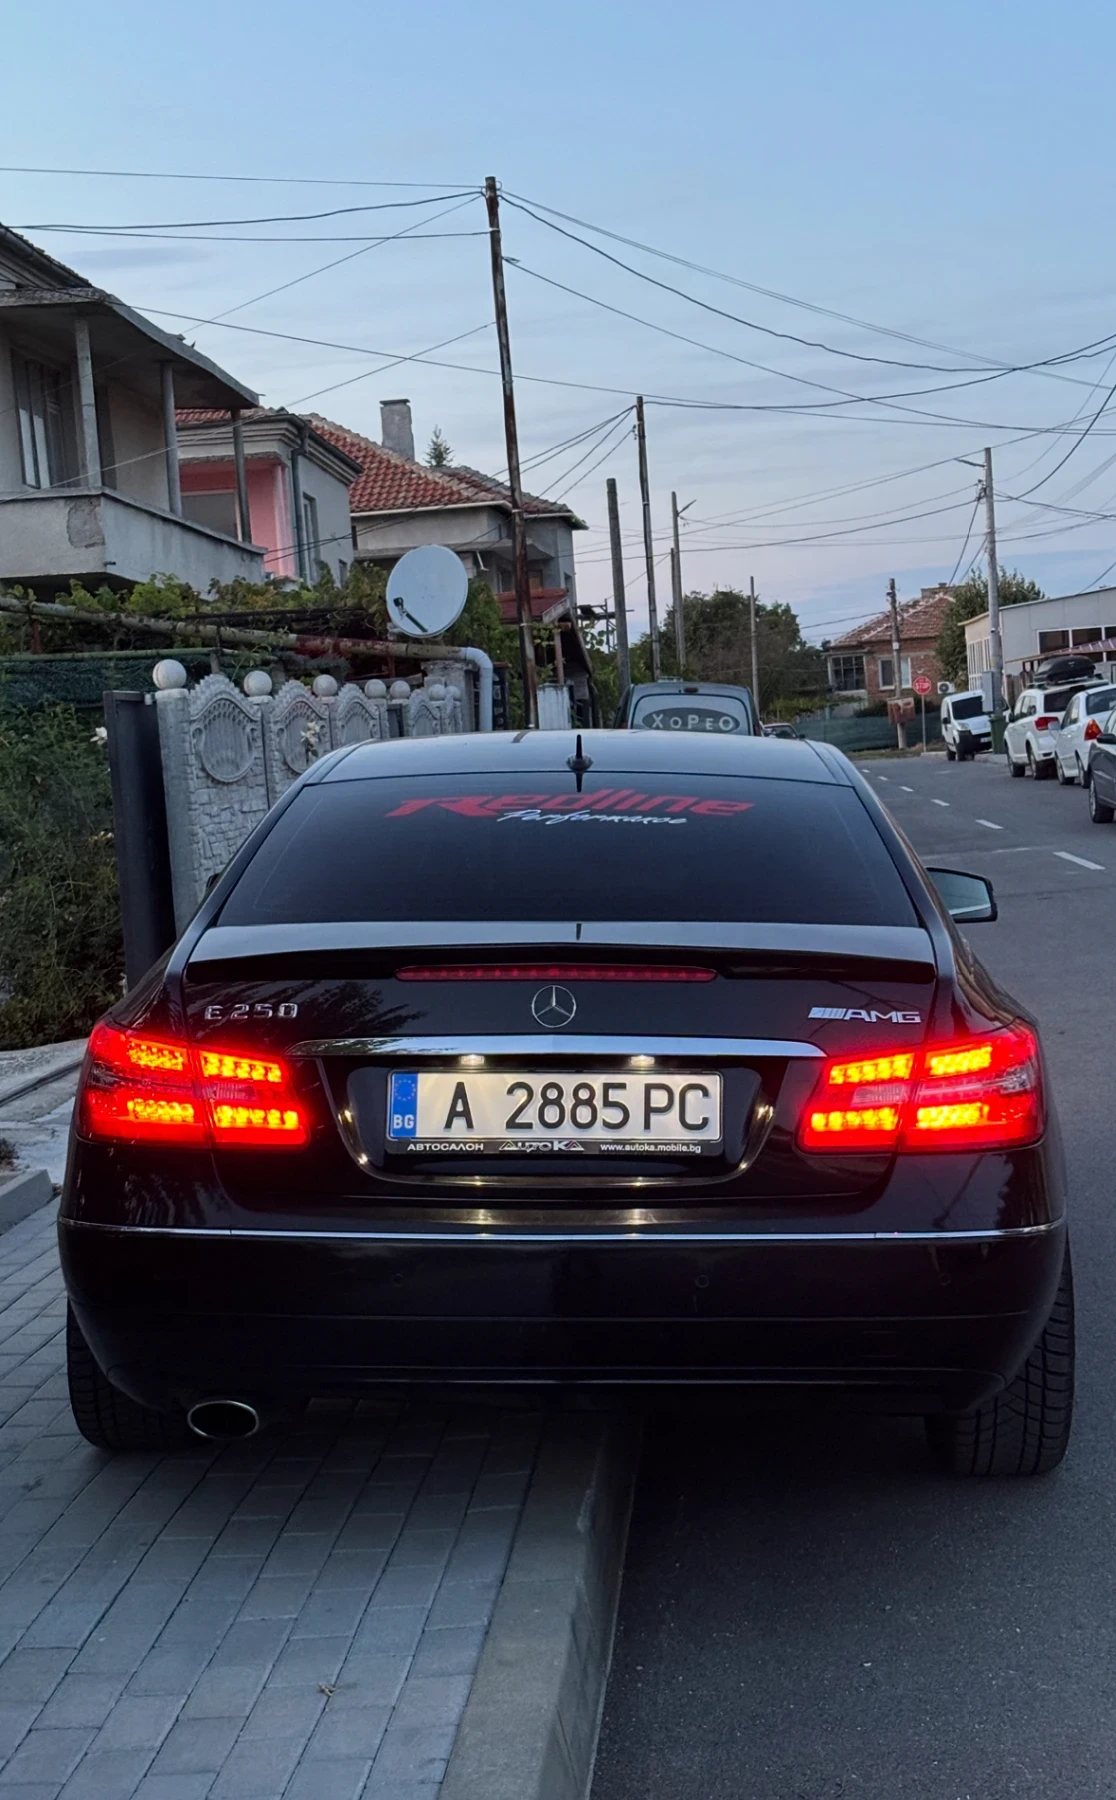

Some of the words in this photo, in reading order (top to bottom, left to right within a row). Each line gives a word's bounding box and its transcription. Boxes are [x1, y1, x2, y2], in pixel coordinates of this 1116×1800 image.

[385, 788, 755, 817] Redline
[497, 809, 687, 824] Performance
[204, 1005, 223, 1020] E
[230, 1003, 298, 1019] 250
[844, 1009, 921, 1023] AMG
[444, 1081, 474, 1129] A
[505, 1082, 630, 1130] 2885
[643, 1083, 710, 1130] PC
[393, 1114, 415, 1129] BG
[407, 1142, 484, 1151] АВТОСАЛОН
[600, 1143, 701, 1153] www.autoka.mobile.bg
